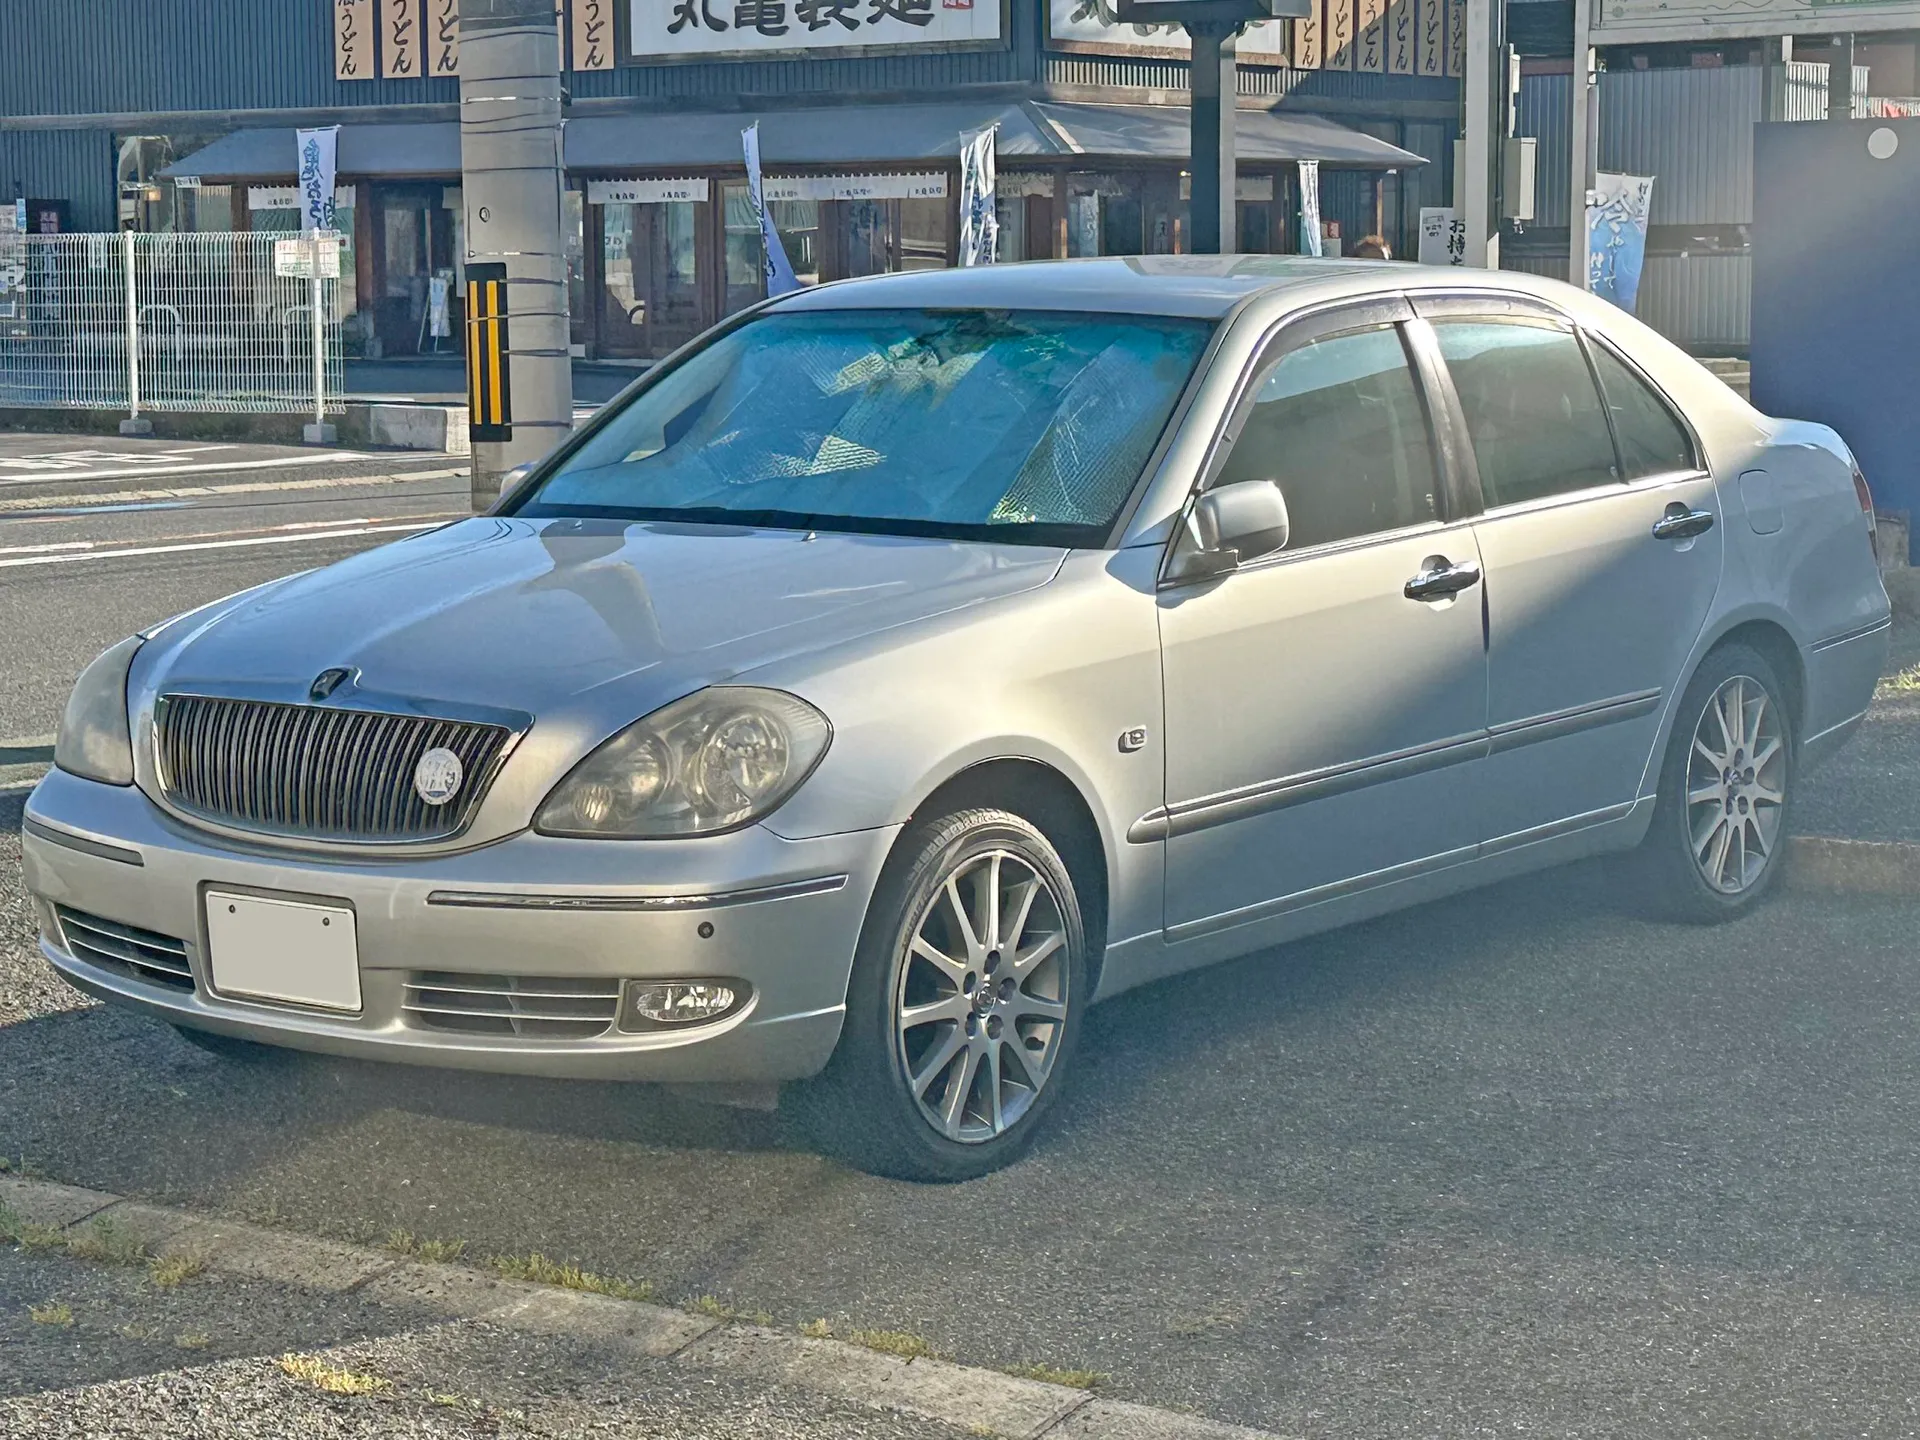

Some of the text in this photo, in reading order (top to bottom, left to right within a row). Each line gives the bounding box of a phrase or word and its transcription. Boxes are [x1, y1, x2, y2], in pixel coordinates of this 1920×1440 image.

[338, 0, 364, 75] うどん
[1452, 0, 1462, 73] うどん
